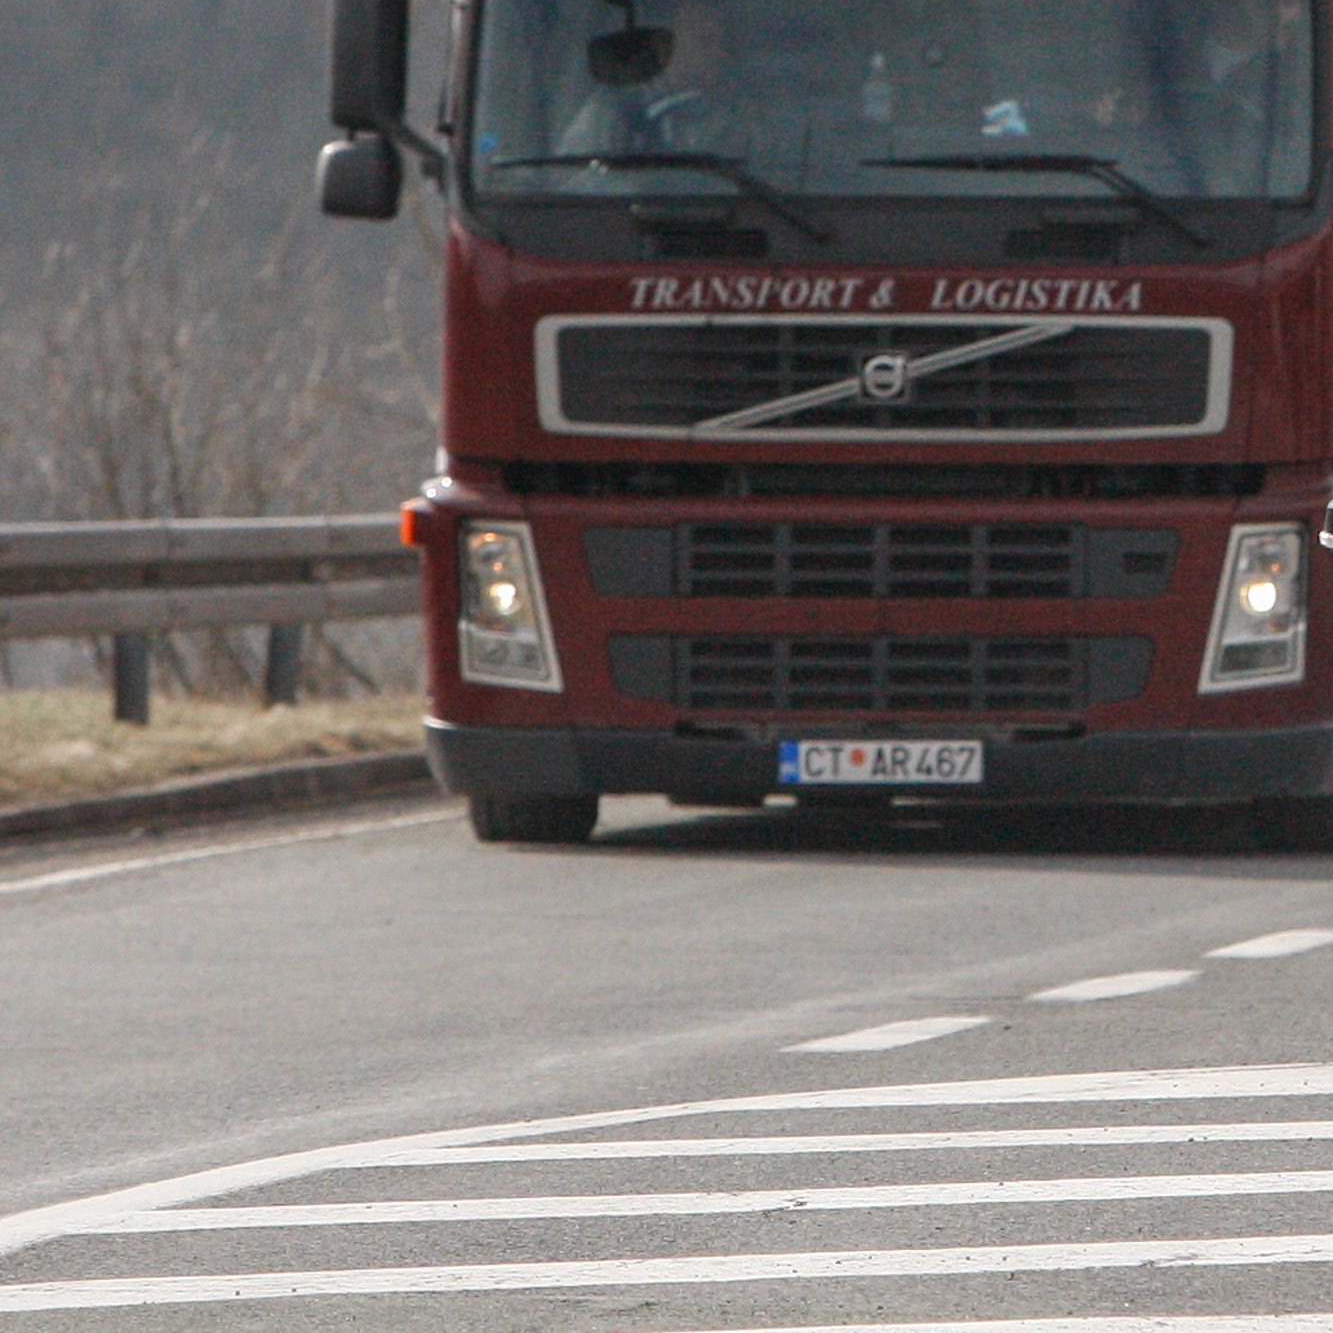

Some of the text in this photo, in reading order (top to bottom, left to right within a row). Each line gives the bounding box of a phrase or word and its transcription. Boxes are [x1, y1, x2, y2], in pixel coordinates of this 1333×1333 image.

[629, 276, 1141, 311] TRANSPORT & LOGISTIKA
[804, 746, 843, 777] CT
